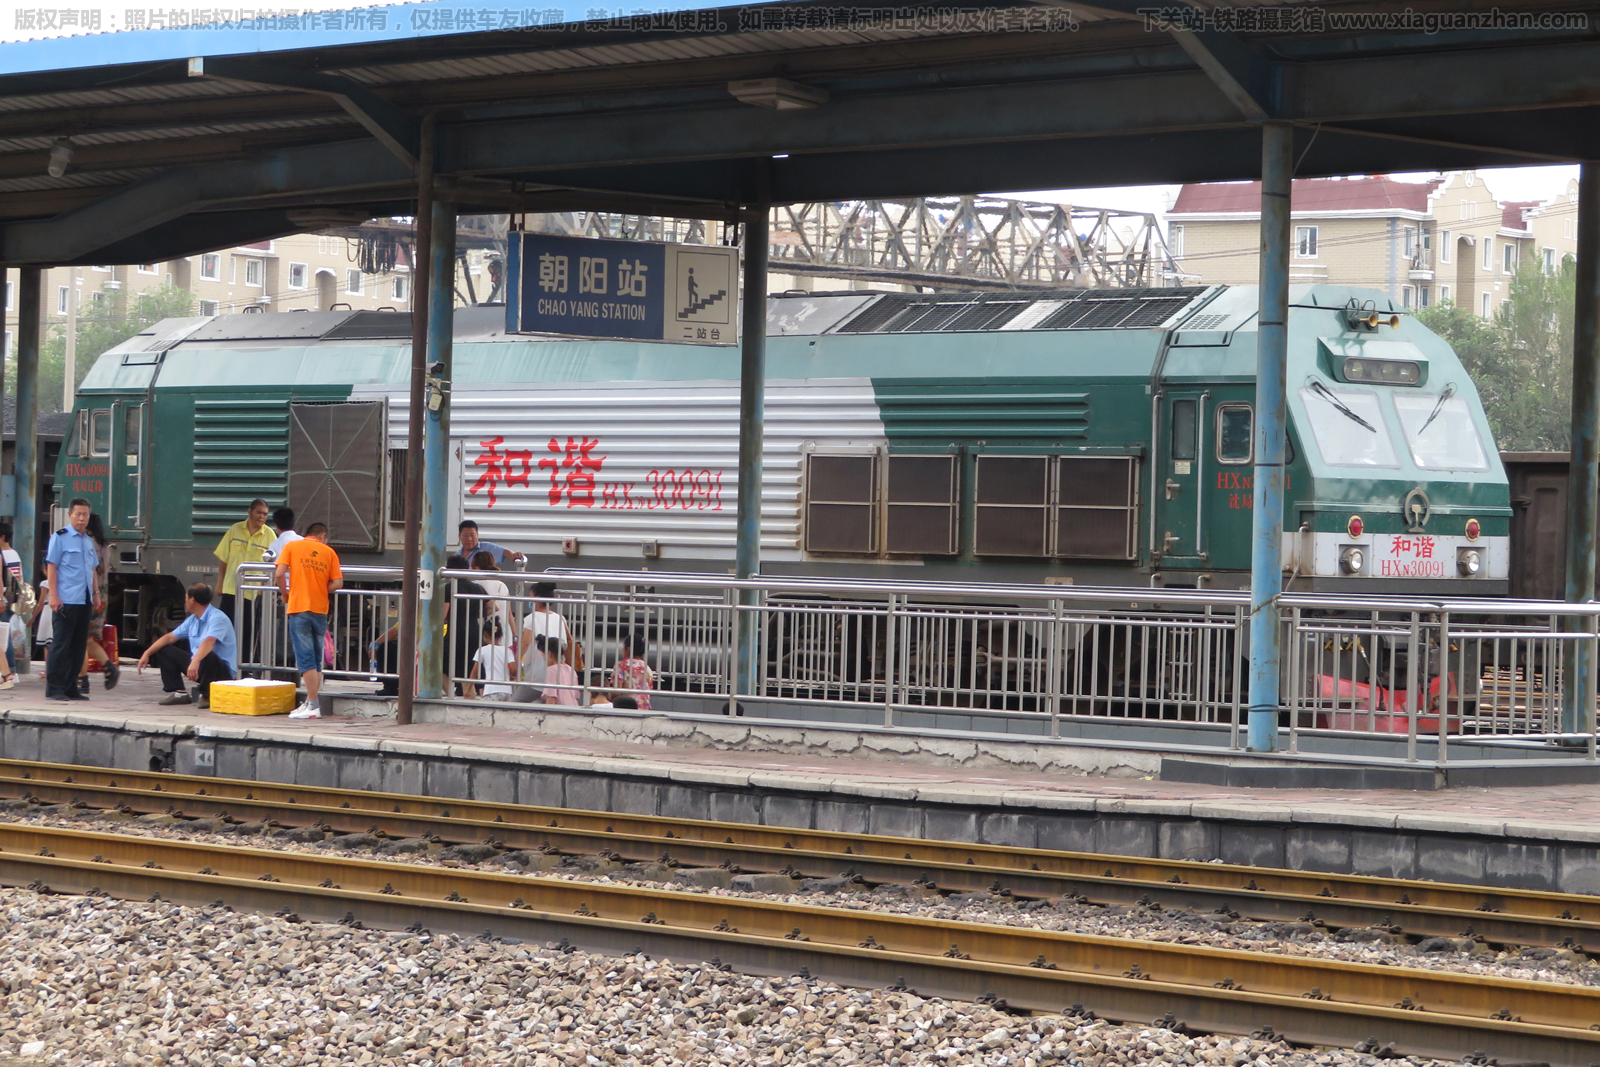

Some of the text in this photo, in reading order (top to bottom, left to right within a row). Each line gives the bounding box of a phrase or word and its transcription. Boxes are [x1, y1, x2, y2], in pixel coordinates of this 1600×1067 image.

[538, 252, 648, 297] 朝阳站
[538, 299, 646, 321] CHAO YANG STATION
[683, 327, 721, 340] 二站台
[469, 435, 606, 508] 和谐
[1390, 535, 1435, 558] 和谐
